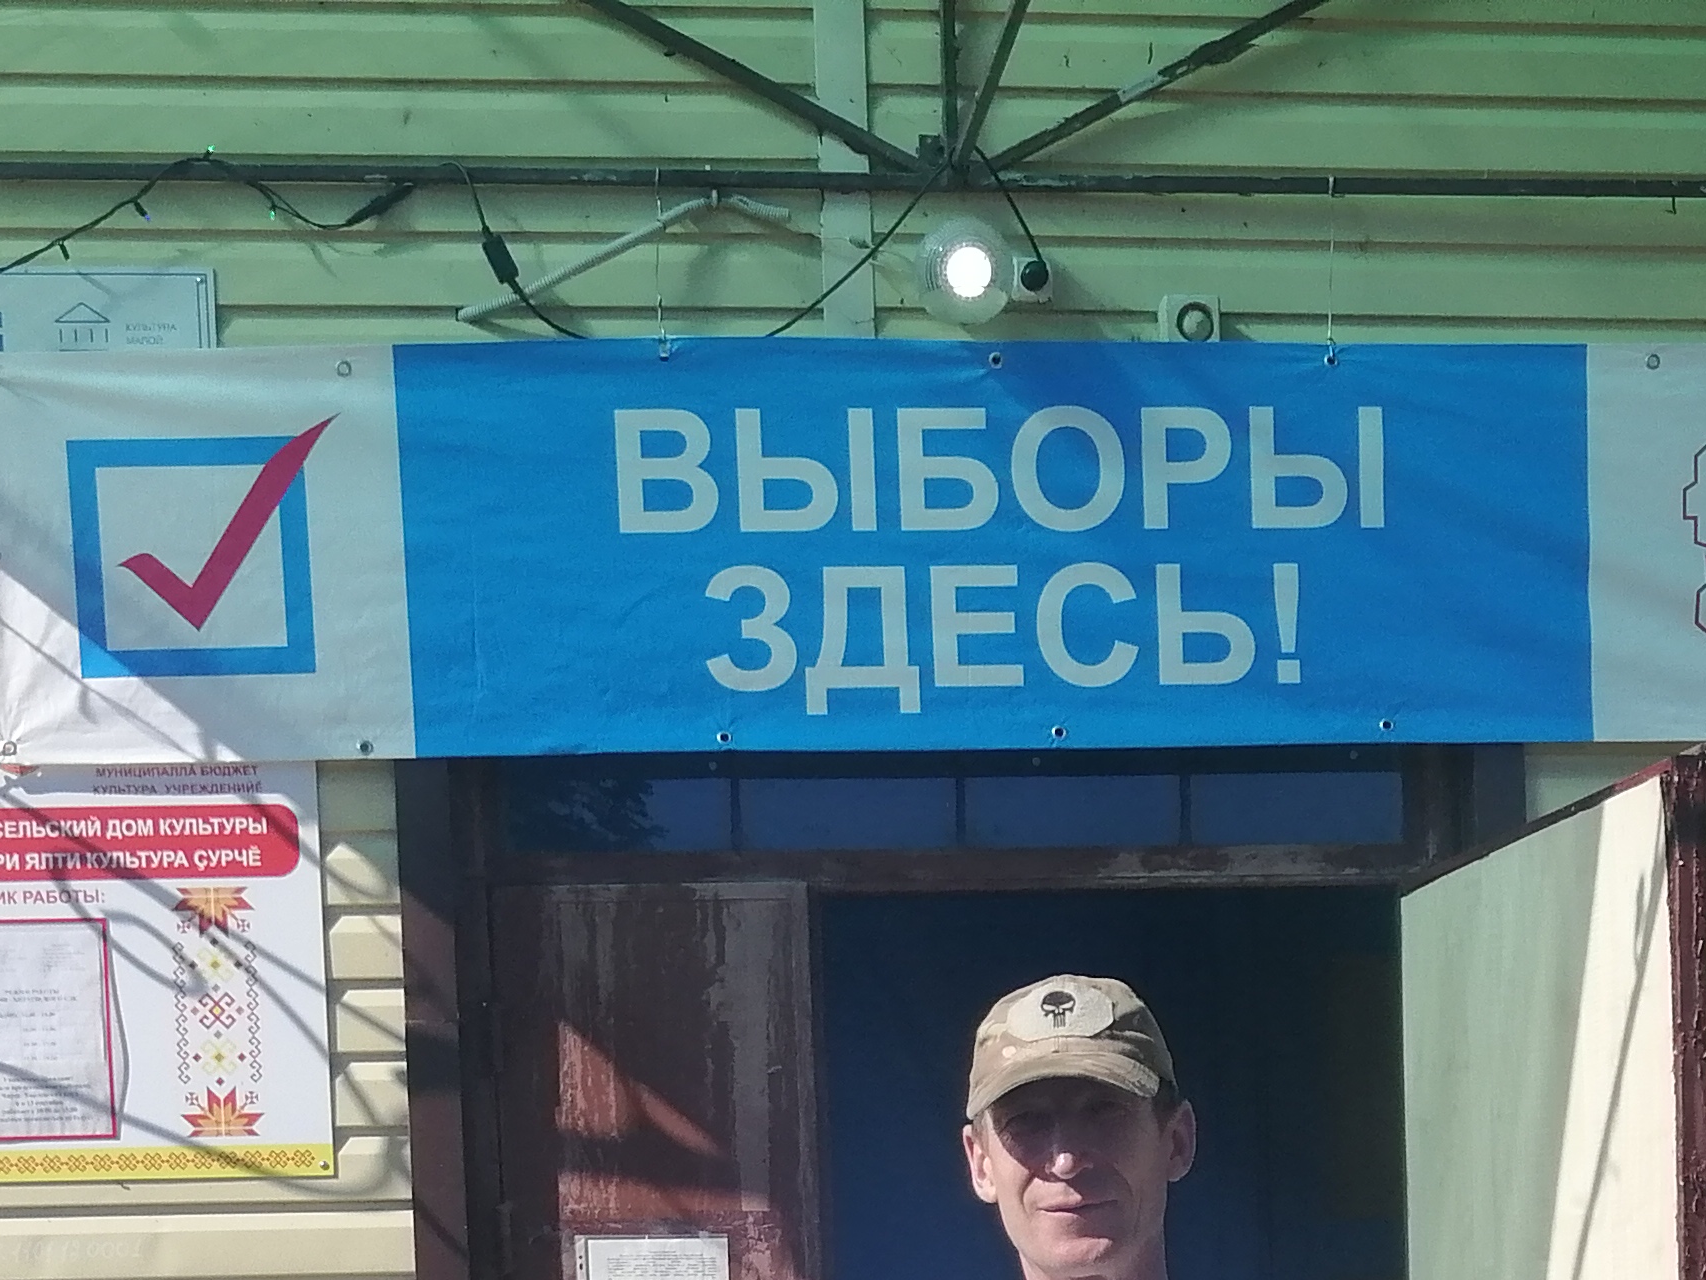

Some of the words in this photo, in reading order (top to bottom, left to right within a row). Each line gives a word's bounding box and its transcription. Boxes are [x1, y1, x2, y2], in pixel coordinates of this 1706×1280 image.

[613, 405, 1386, 535] ВЫБОРЫ
[704, 562, 1302, 716] ЗДЕСЬ!
[200, 764, 259, 778] БЮДЖЕТ
[93, 783, 158, 795] КУЛЬТУРА
[106, 818, 154, 840] ДОМ
[159, 815, 268, 837] КУЛЬТУРЫ
[25, 851, 81, 871] ЯЛТИ
[85, 850, 190, 870] КУЛЬТУРА
[22, 888, 106, 906] РАБОТЫ:
